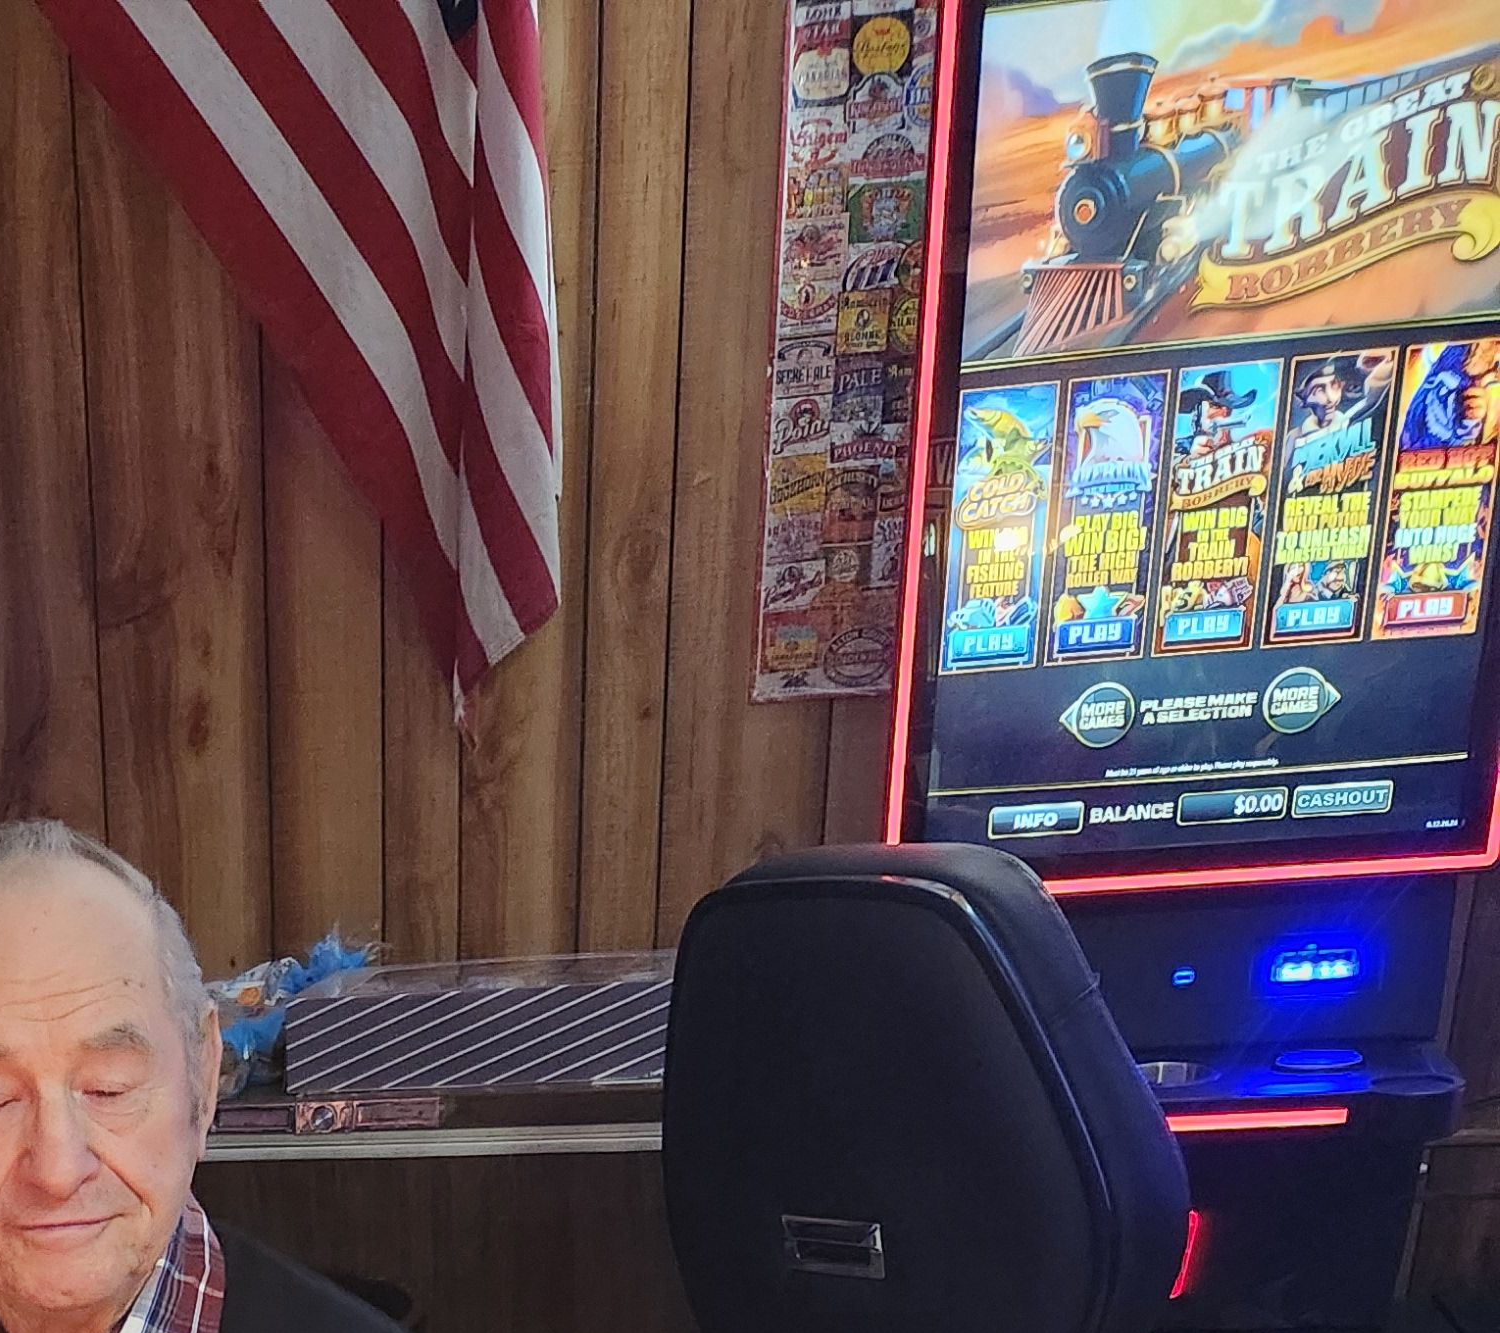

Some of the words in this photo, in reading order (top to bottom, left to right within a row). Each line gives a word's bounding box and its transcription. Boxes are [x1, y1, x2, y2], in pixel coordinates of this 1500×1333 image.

[1257, 132, 1329, 174] THE
[1339, 71, 1472, 142] GREAT
[1219, 99, 1500, 260] TRAIN
[1225, 198, 1473, 300] ROBBERY
[838, 368, 882, 394] PALE
[1177, 446, 1265, 495] TRAIN
[1394, 465, 1494, 489] BUFFALO
[969, 472, 1026, 501] COLD
[1181, 475, 1255, 509] ROBBERY
[1284, 495, 1338, 516] REVEAL
[1340, 491, 1371, 513] THE
[1401, 486, 1483, 511] STAMPEDE
[1076, 513, 1110, 533] PLAY
[1111, 510, 1139, 530] BIG
[1183, 509, 1216, 532] WIN
[1217, 505, 1249, 528] BIG
[1283, 514, 1318, 532] WILD
[1319, 510, 1367, 529] POTION
[1400, 508, 1441, 529] YOUR
[1443, 504, 1479, 526] WAY
[1065, 532, 1104, 557] WIN
[1106, 527, 1147, 552] BIG!
[1277, 531, 1298, 550] TO
[1300, 525, 1371, 547] UNLEASH
[1434, 523, 1477, 545] HUGE
[1188, 539, 1235, 562] TRAIN
[1408, 542, 1459, 564] WINS!
[967, 561, 1024, 584] FISHING
[1069, 554, 1097, 574] THE
[1100, 551, 1136, 572] HIGH
[1171, 556, 1249, 582] ROBBERY!
[969, 580, 1019, 598] FEATURE
[1067, 571, 1109, 588] ROLLER
[1111, 568, 1138, 585] WAY
[1286, 606, 1341, 627] PLAY
[1397, 597, 1453, 619] PLAY
[1068, 623, 1122, 645] PLAY
[1177, 615, 1229, 636] PLAY
[963, 634, 1014, 654] PLAY
[1139, 696, 1206, 714] PLEASE
[1208, 691, 1258, 708] MAKE
[1273, 685, 1320, 702] MORE
[1081, 701, 1126, 717] MORE
[1142, 711, 1155, 725] A
[1157, 704, 1252, 723] SELECTION
[1270, 698, 1319, 715] GAMES
[1079, 714, 1125, 731] GAMES
[1088, 803, 1174, 825] BALANCE
[1233, 793, 1284, 815] $0.00
[1297, 789, 1388, 809] CASHOUT
[1013, 812, 1059, 830] INFO
